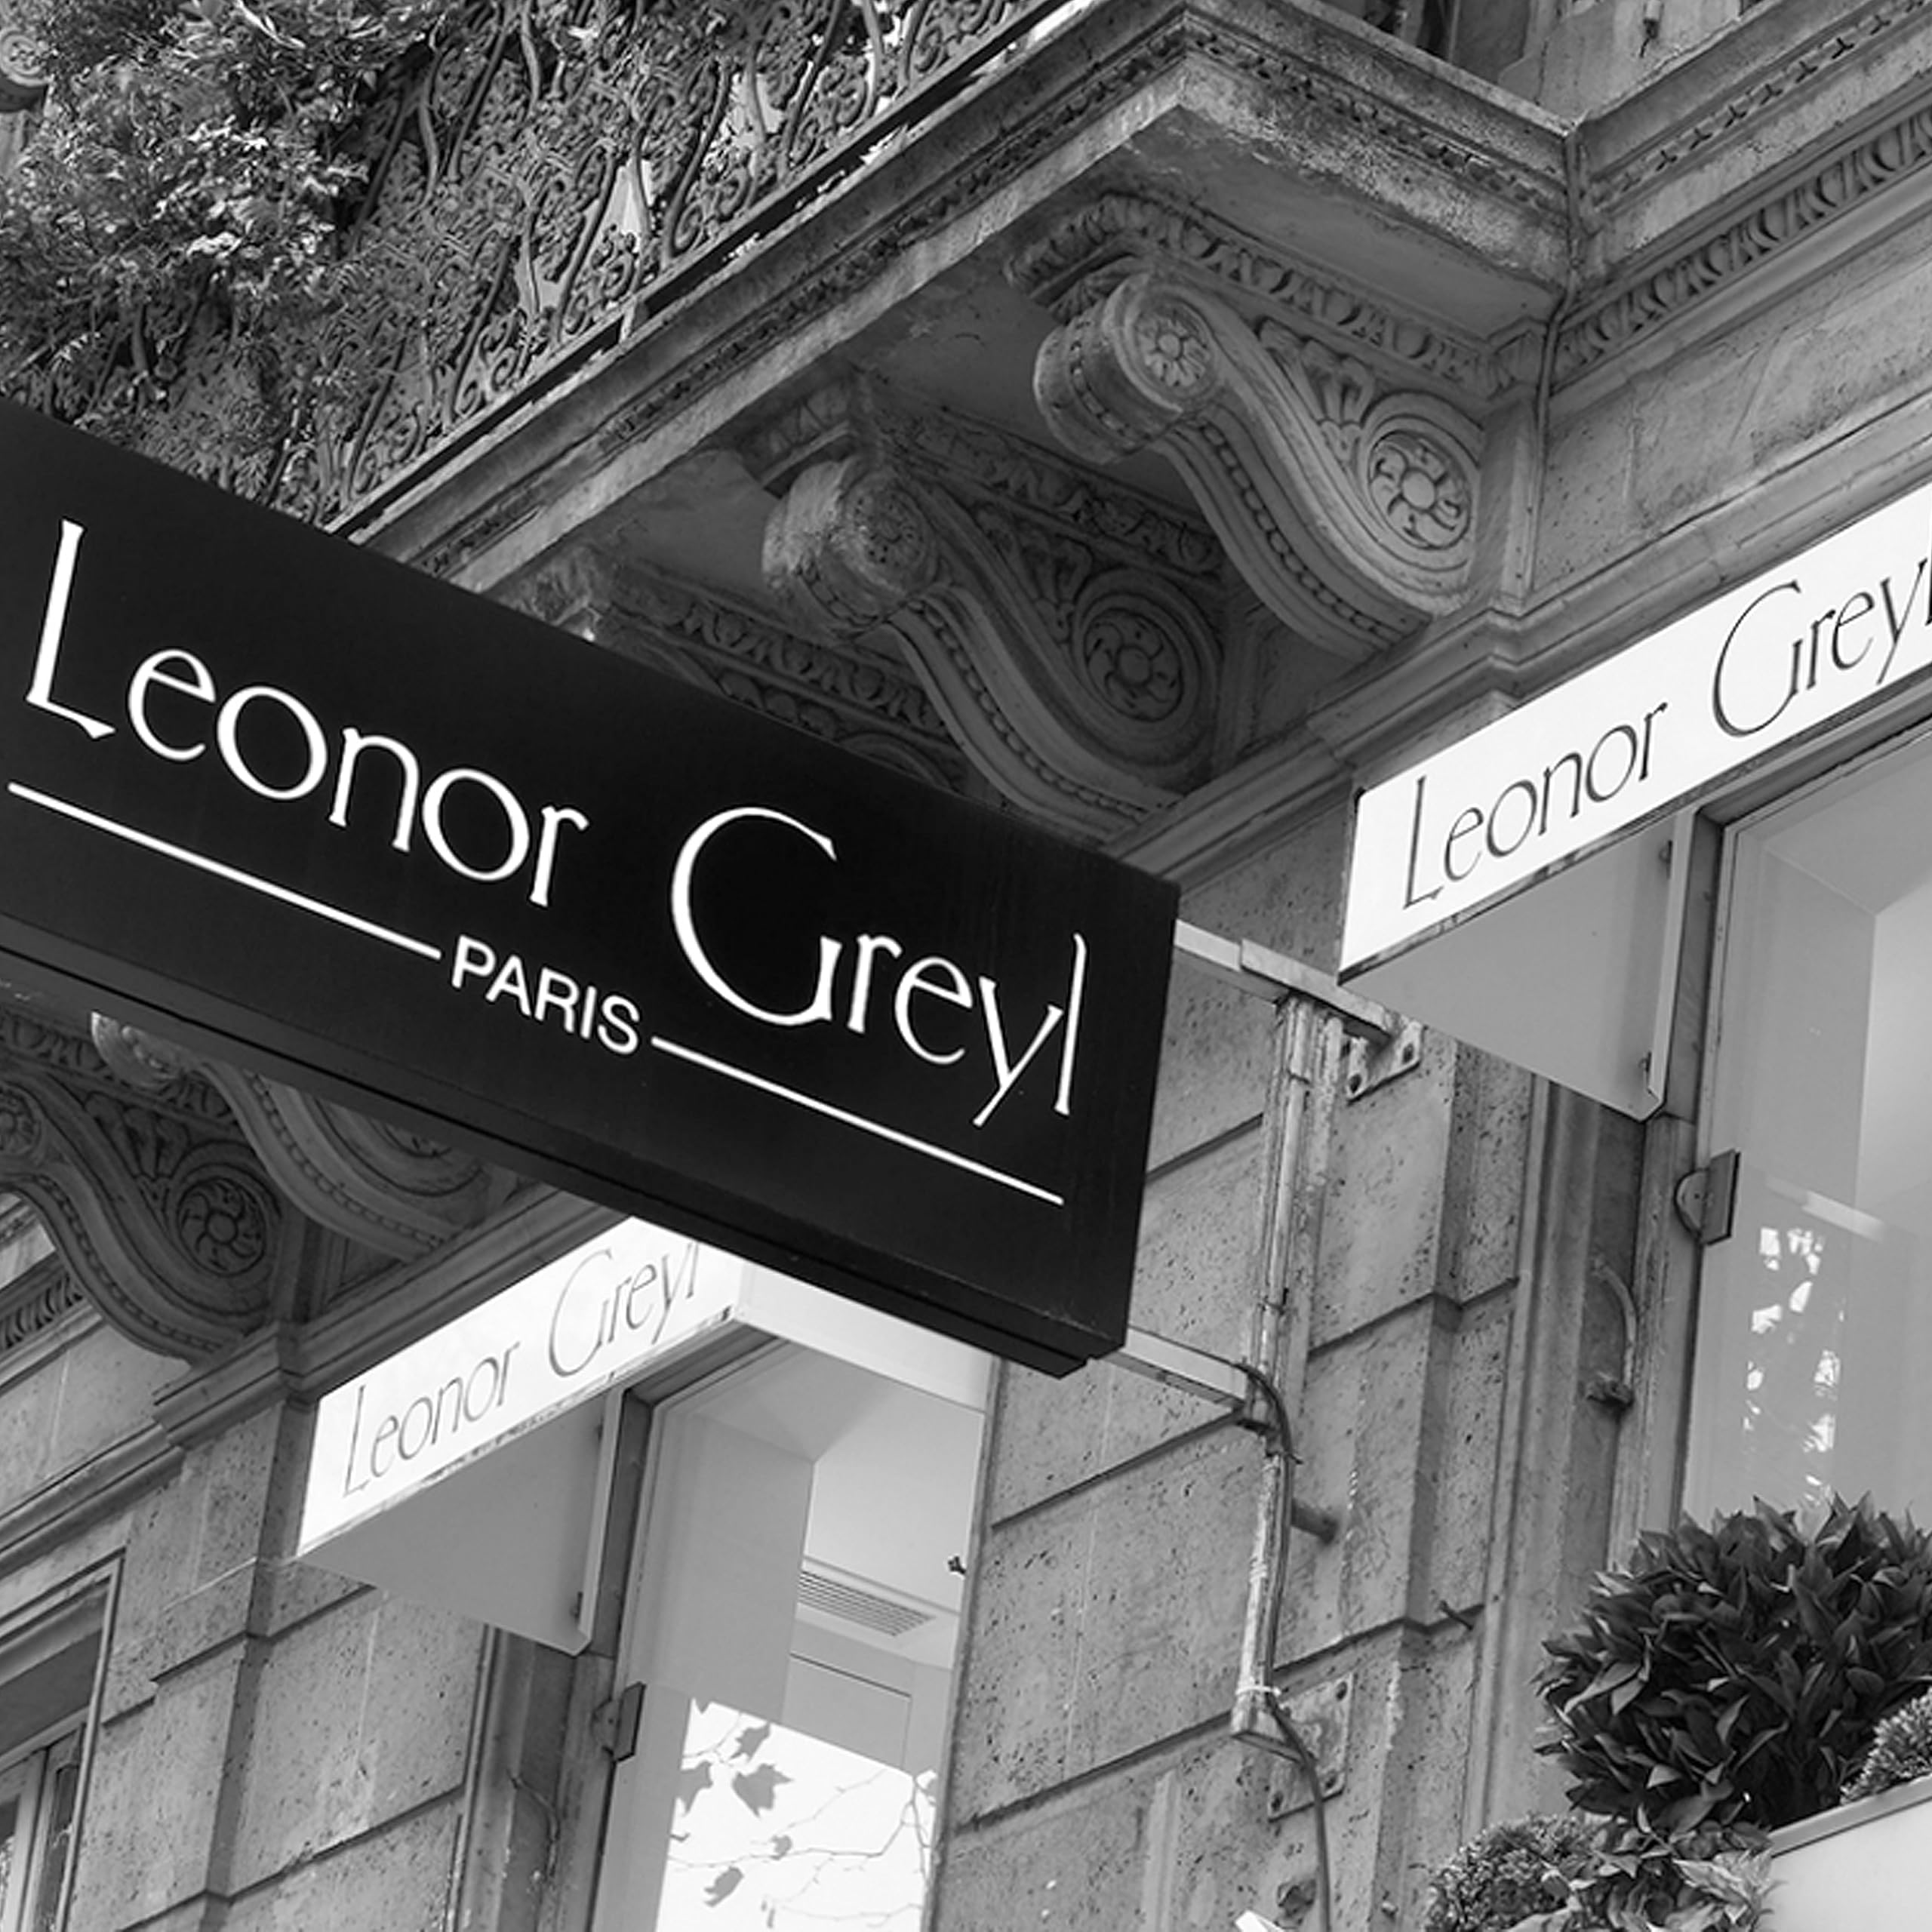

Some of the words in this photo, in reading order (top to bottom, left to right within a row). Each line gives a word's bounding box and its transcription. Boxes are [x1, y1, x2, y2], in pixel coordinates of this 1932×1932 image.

[26, 518, 589, 906] Leonor
[671, 806, 1086, 1127] Greyl
[1403, 703, 1668, 909] Leonor
[452, 935, 640, 1055] PARIS
[343, 1340, 519, 1497] Leonor
